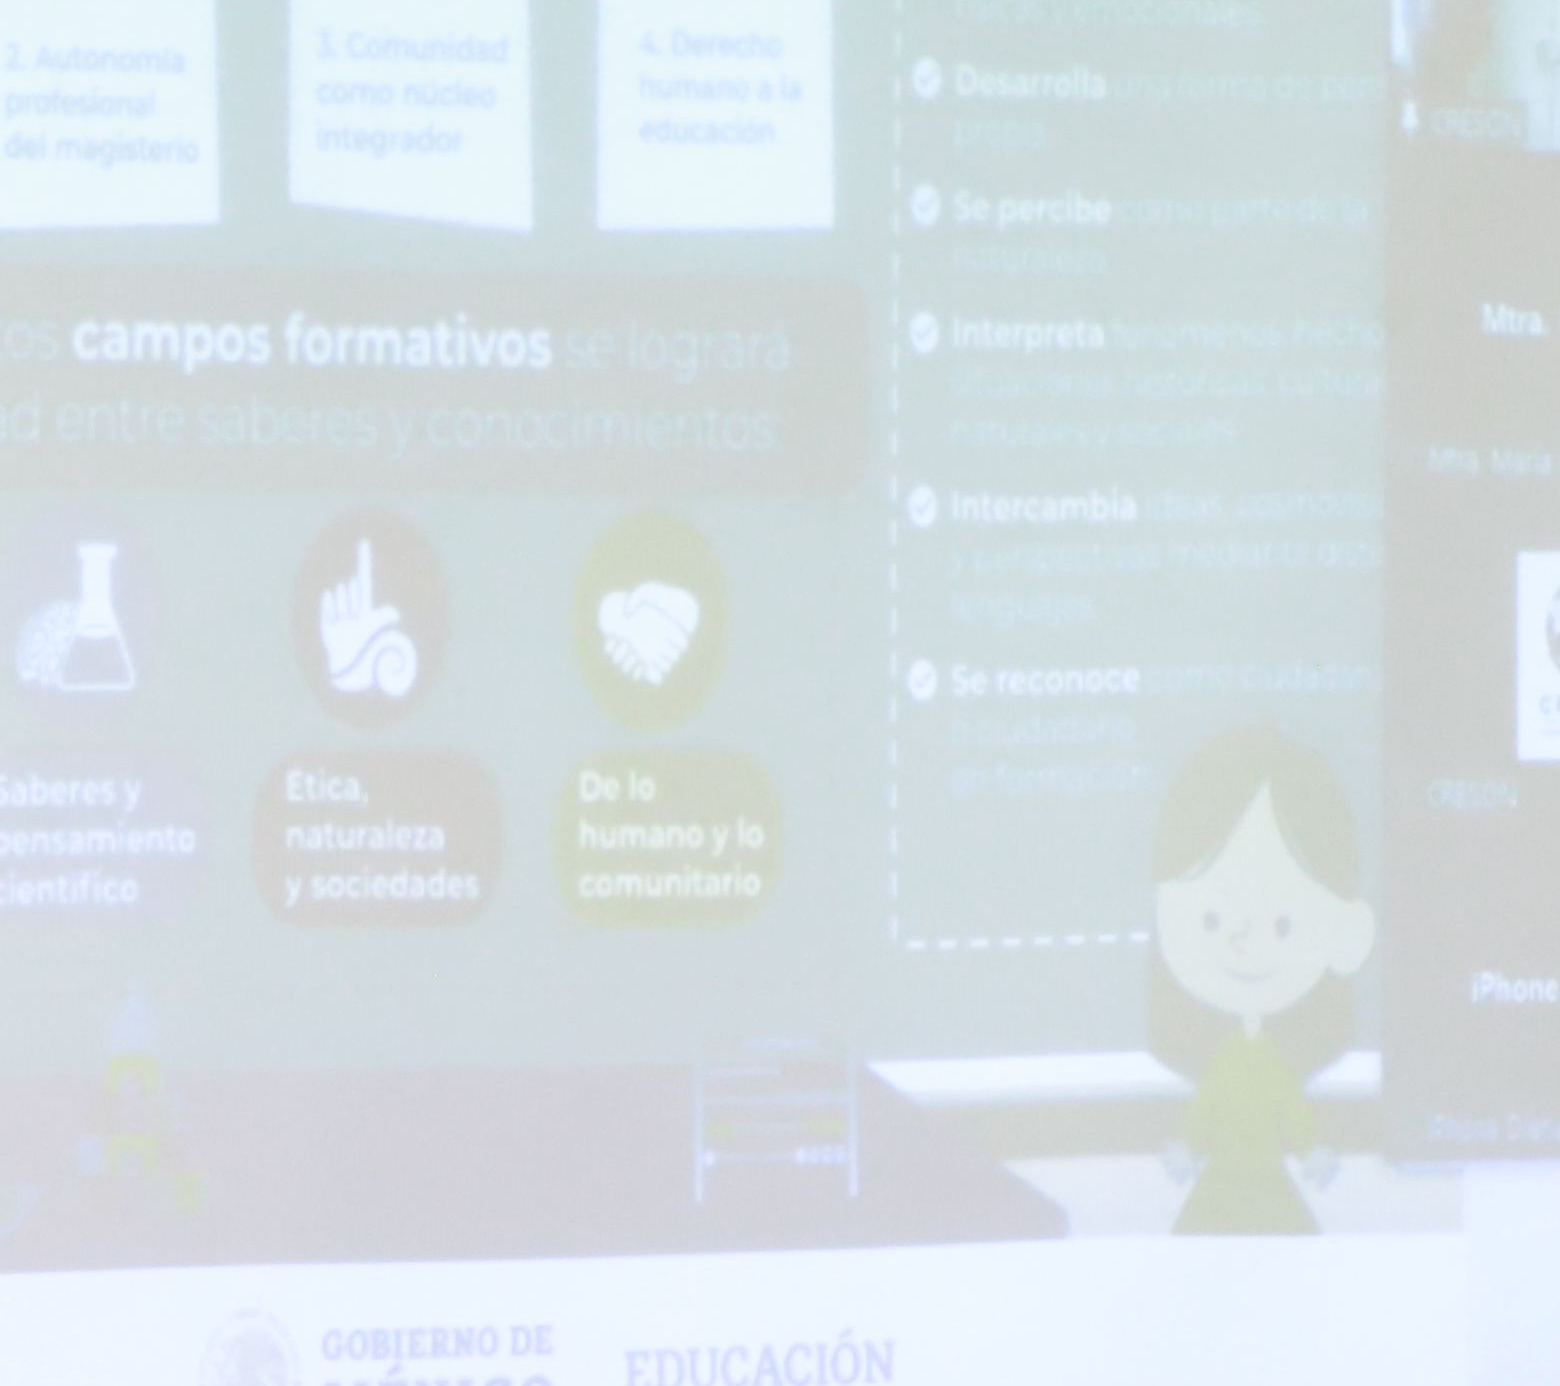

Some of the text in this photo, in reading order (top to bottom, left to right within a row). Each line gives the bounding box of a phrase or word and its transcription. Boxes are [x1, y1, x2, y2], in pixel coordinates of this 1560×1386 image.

[344, 29, 510, 66] Comunidad
[669, 25, 787, 63] Derecho
[315, 79, 395, 108] como
[637, 69, 804, 105] humano a la
[952, 62, 1109, 101] Desarrolla
[3, 85, 158, 124] profesional
[3, 130, 202, 169] del magisterio
[315, 122, 466, 160] integrador
[952, 189, 990, 226] Se
[996, 188, 1116, 233] percibe
[951, 316, 1107, 358] Interpreta
[1481, 301, 1550, 338] Mtra.
[70, 315, 274, 376] campos
[282, 307, 555, 373] formativos
[563, 325, 615, 373] se
[54, 401, 185, 445] entre
[202, 397, 379, 448] saberes
[387, 413, 413, 460] y
[425, 406, 778, 452] conocimientos
[950, 485, 1141, 525] Intercambia
[950, 662, 990, 697] Se
[994, 665, 1143, 697] reconoce
[121, 776, 144, 814] y
[577, 767, 658, 804] De lo
[284, 817, 448, 853] naturaleza
[577, 815, 766, 859] humano y lo
[283, 865, 482, 909] y sociedades
[576, 864, 762, 901] comunitario
[1470, 969, 1560, 1006] iPhone
[320, 1321, 555, 1363] GOBIERNO DE
